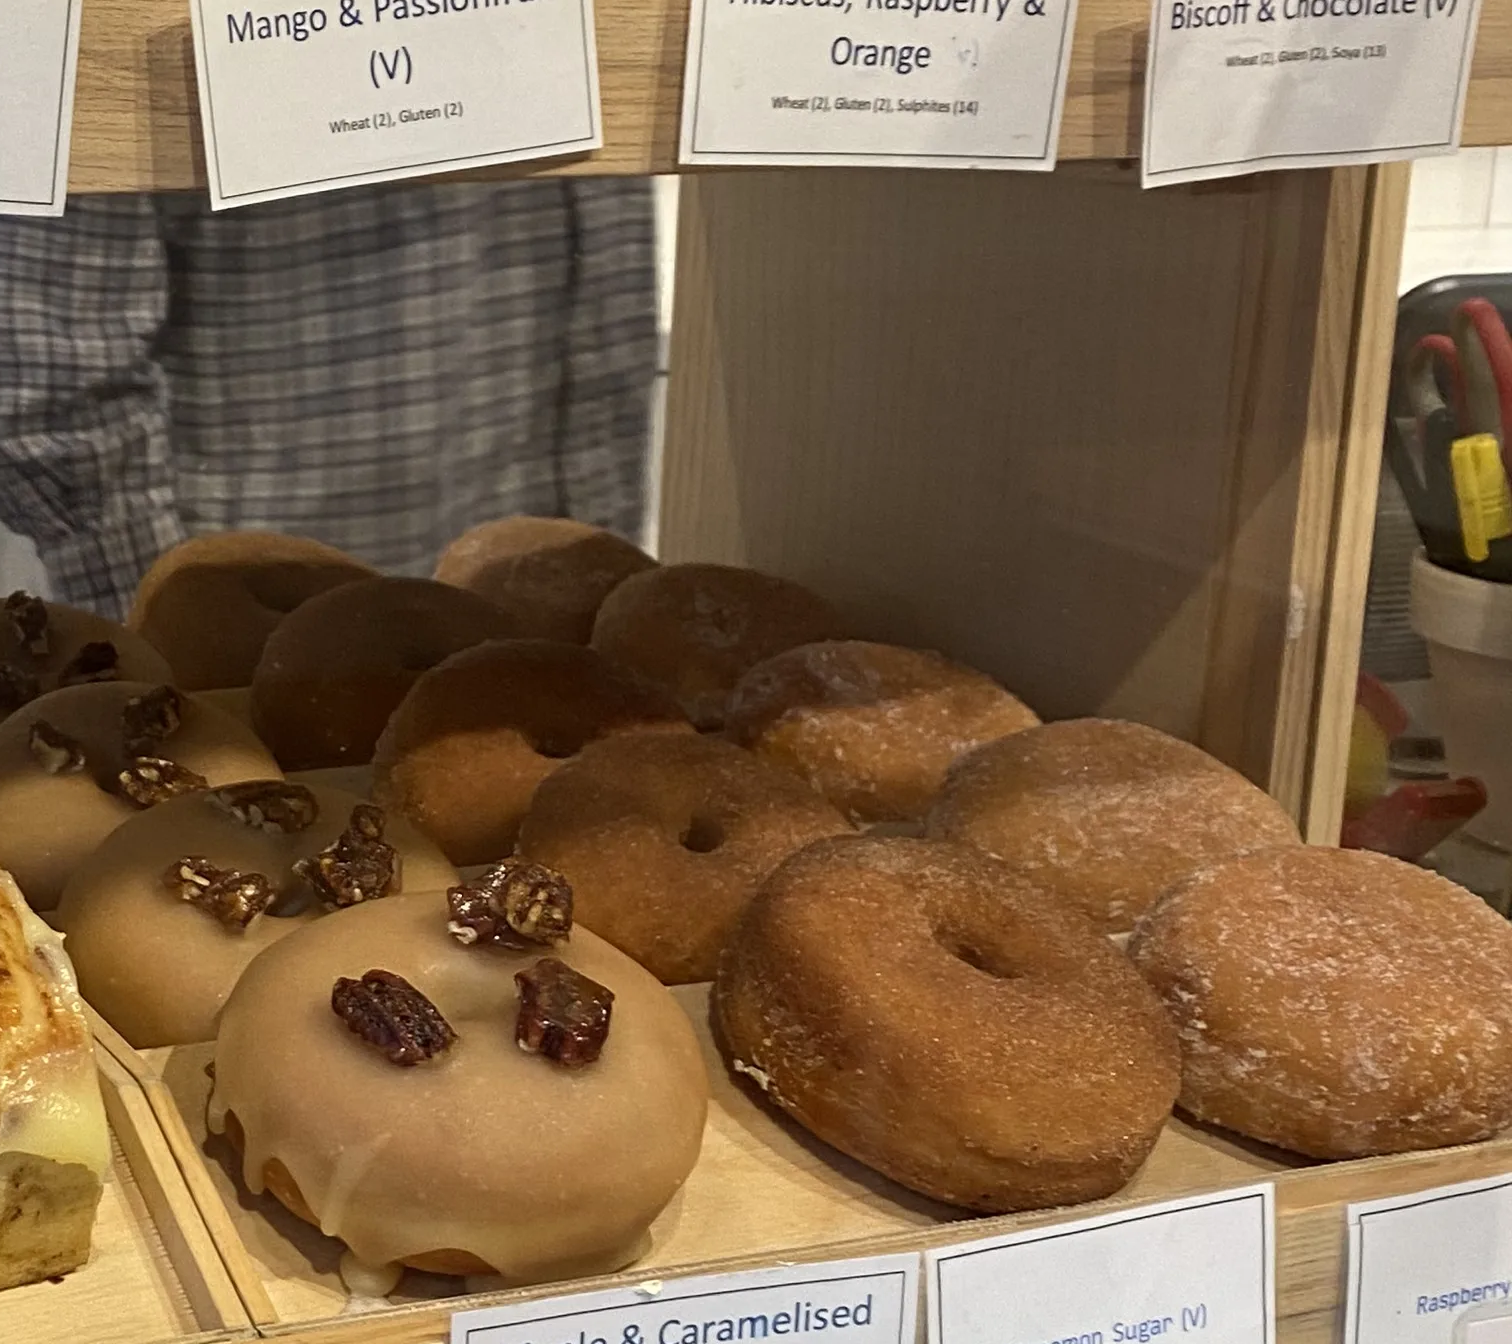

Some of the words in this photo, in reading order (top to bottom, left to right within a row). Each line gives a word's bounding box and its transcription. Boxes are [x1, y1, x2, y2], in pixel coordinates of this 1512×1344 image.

[225, 7, 328, 44] Mango
[368, 45, 414, 90] (V)
[830, 35, 933, 75] Orange
[328, 115, 372, 135] Wheat
[373, 111, 397, 130] (2),
[398, 105, 442, 126] Gluten
[443, 101, 465, 120] (2)
[771, 96, 809, 110] Wheat
[834, 96, 872, 111] Gluten
[896, 98, 952, 115] Sulphites
[953, 99, 980, 117] (14)
[1415, 1279, 1512, 1315] Raspberry
[1182, 1303, 1209, 1332] (V)
